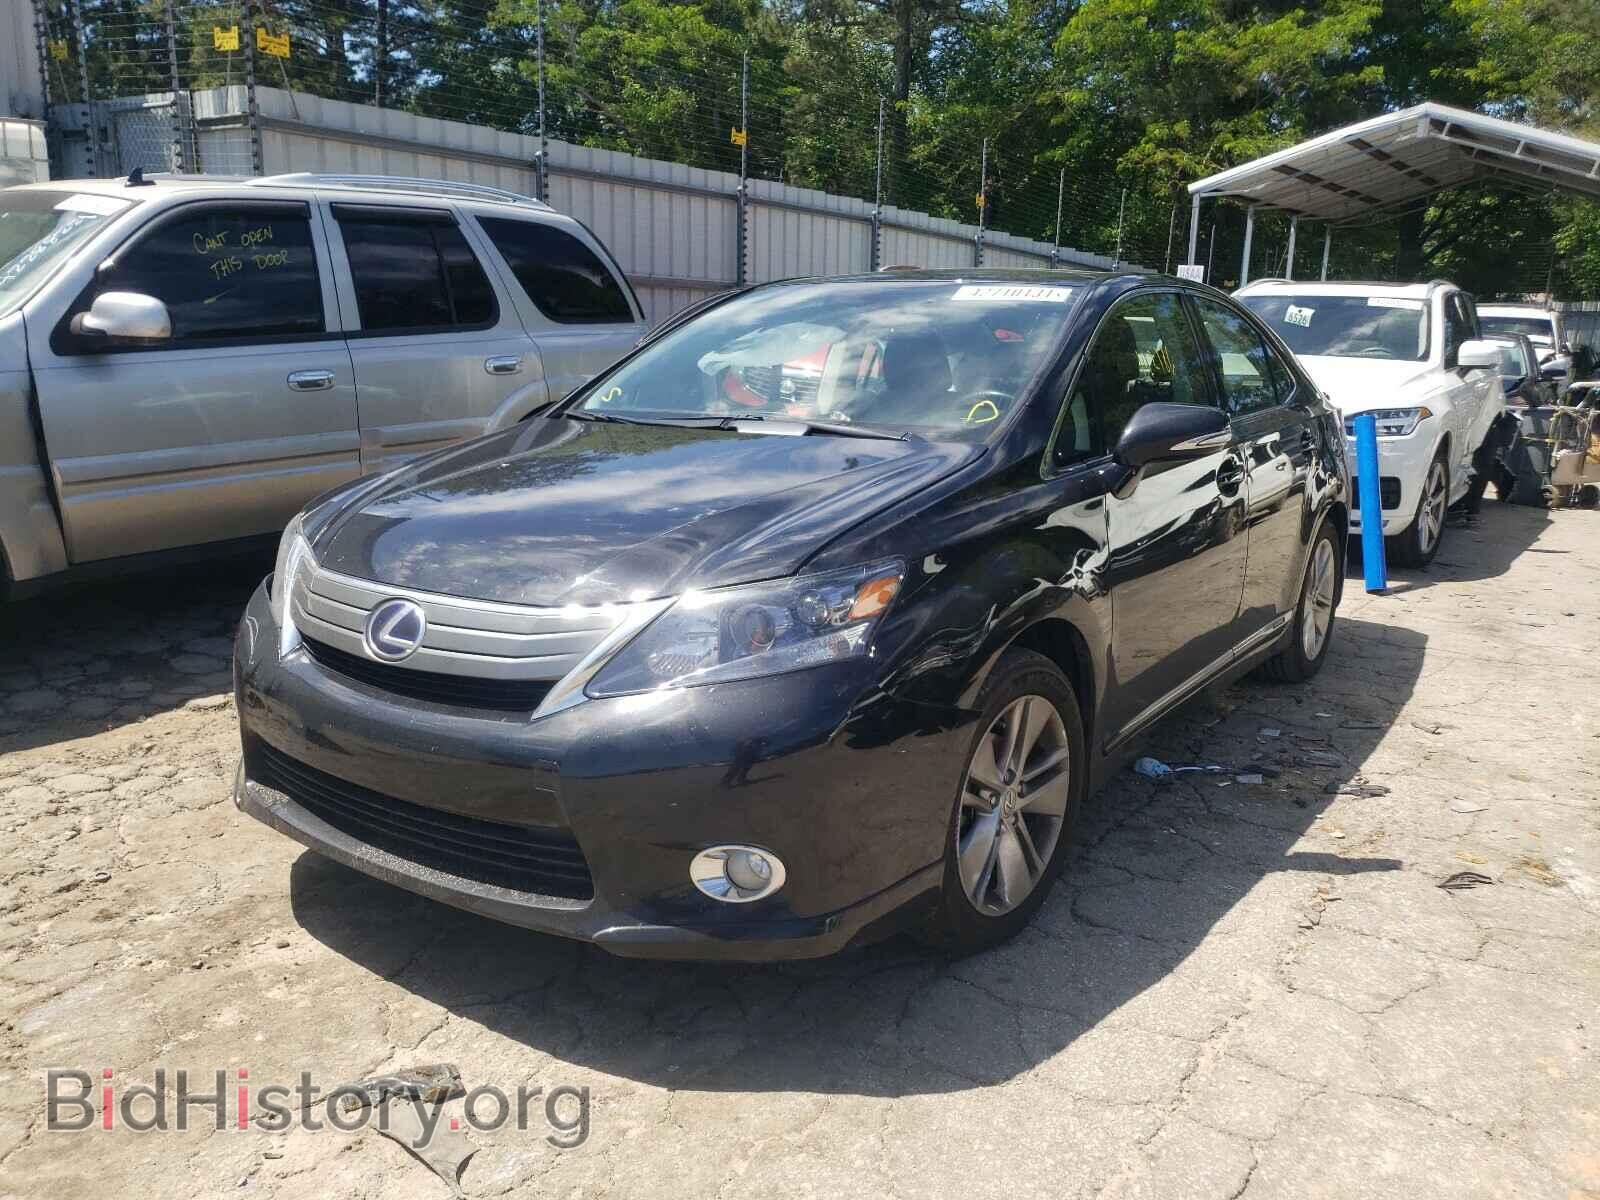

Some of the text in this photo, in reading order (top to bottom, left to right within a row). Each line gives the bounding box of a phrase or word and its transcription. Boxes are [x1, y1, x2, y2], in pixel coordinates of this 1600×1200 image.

[241, 225, 273, 249] OPEN
[210, 249, 294, 280] THIS DOOR
